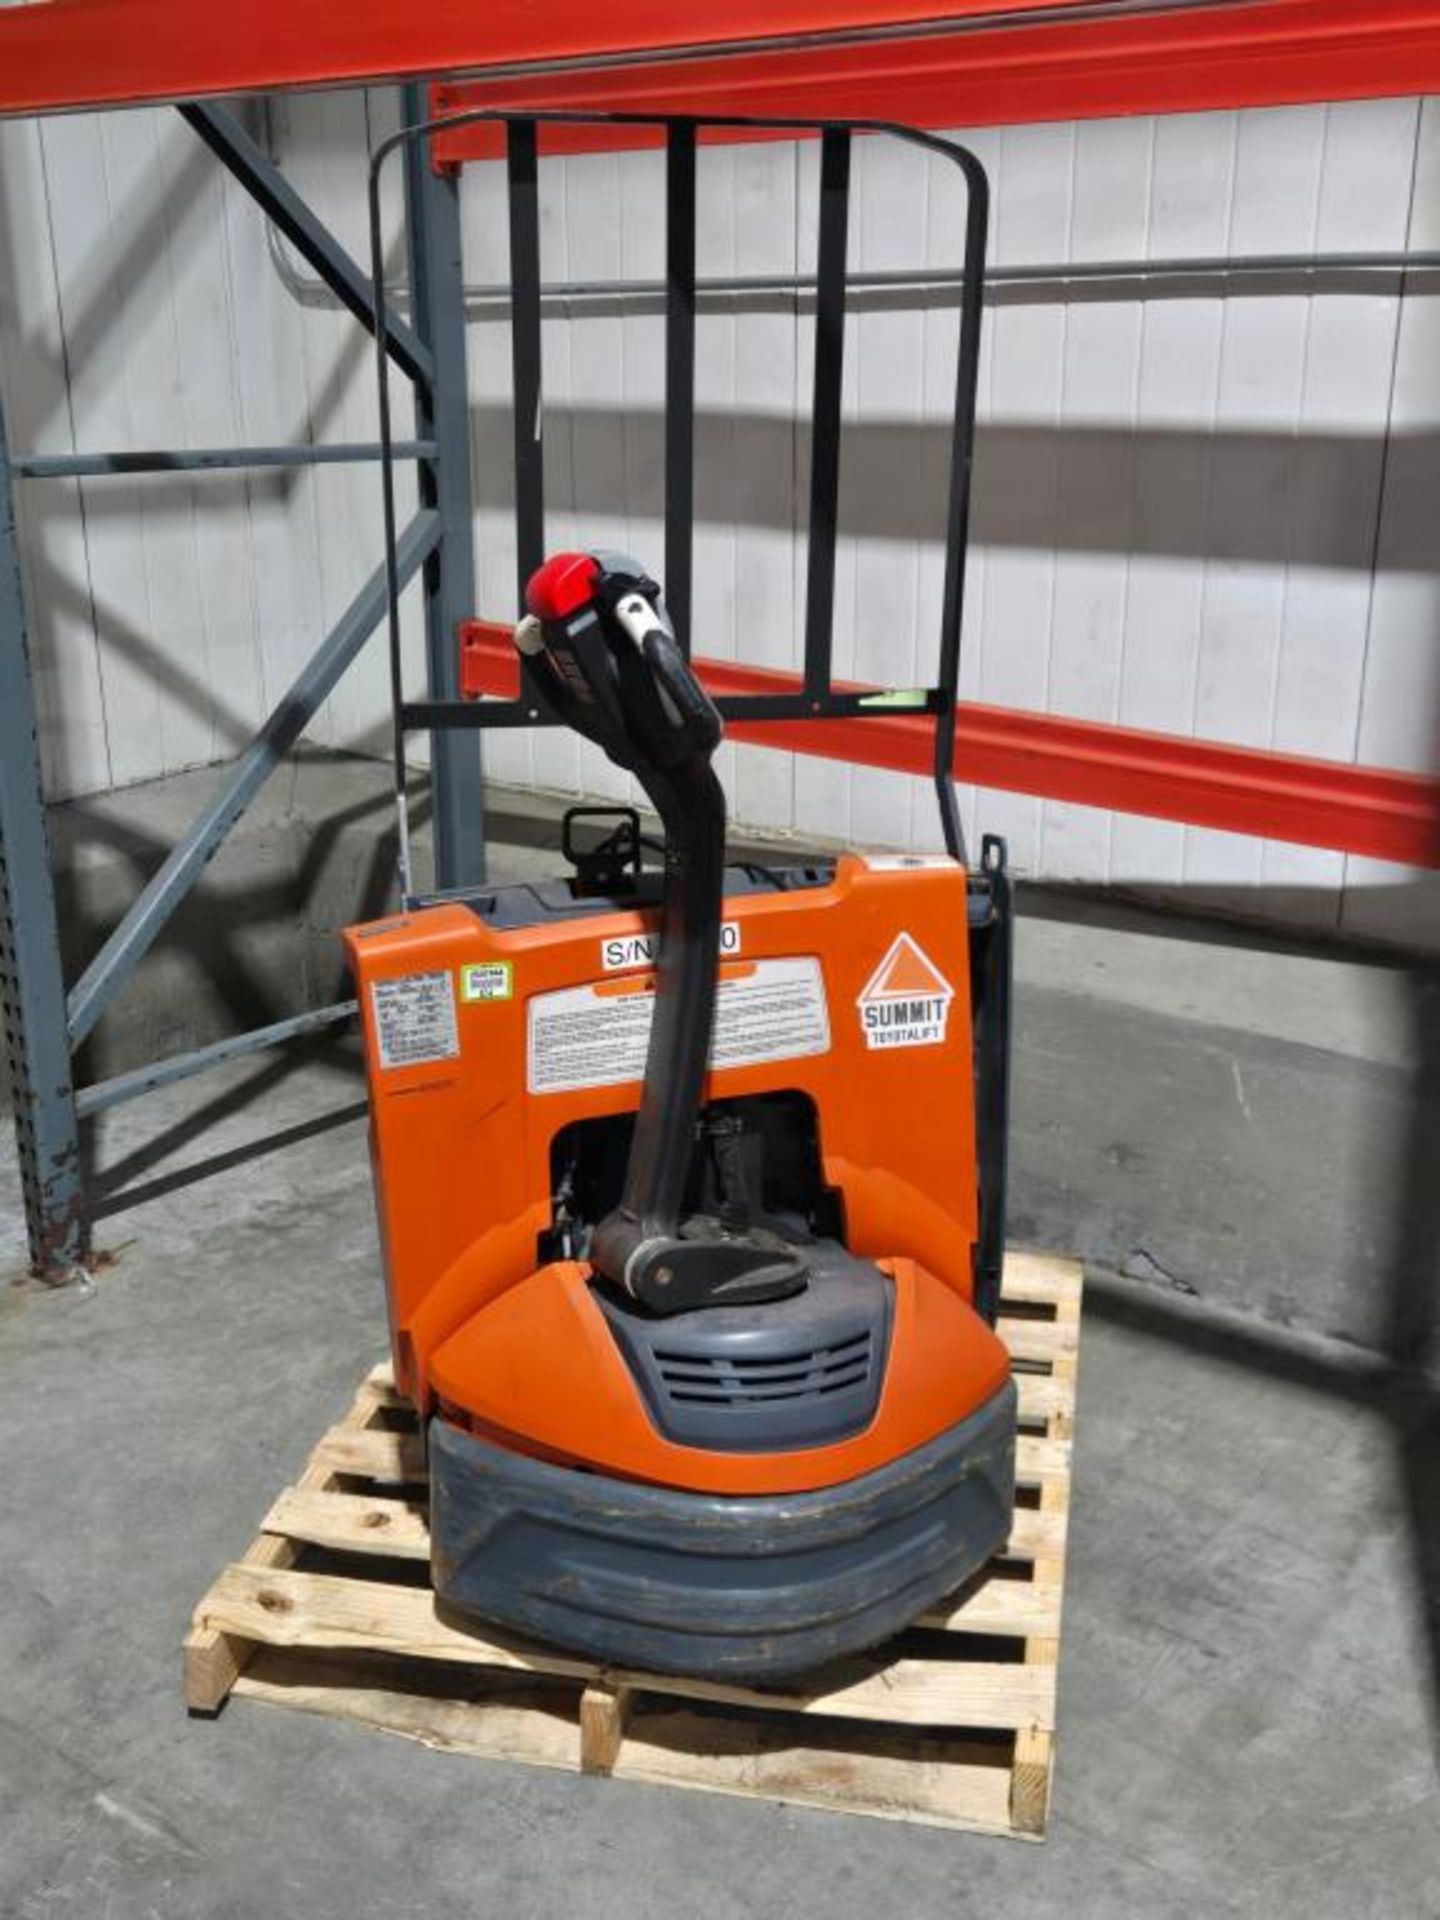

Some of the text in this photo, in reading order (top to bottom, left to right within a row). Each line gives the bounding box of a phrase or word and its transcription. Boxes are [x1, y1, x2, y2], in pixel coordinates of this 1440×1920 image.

[607, 927, 736, 965] S/N 0
[865, 998, 945, 1028] SUMMIT
